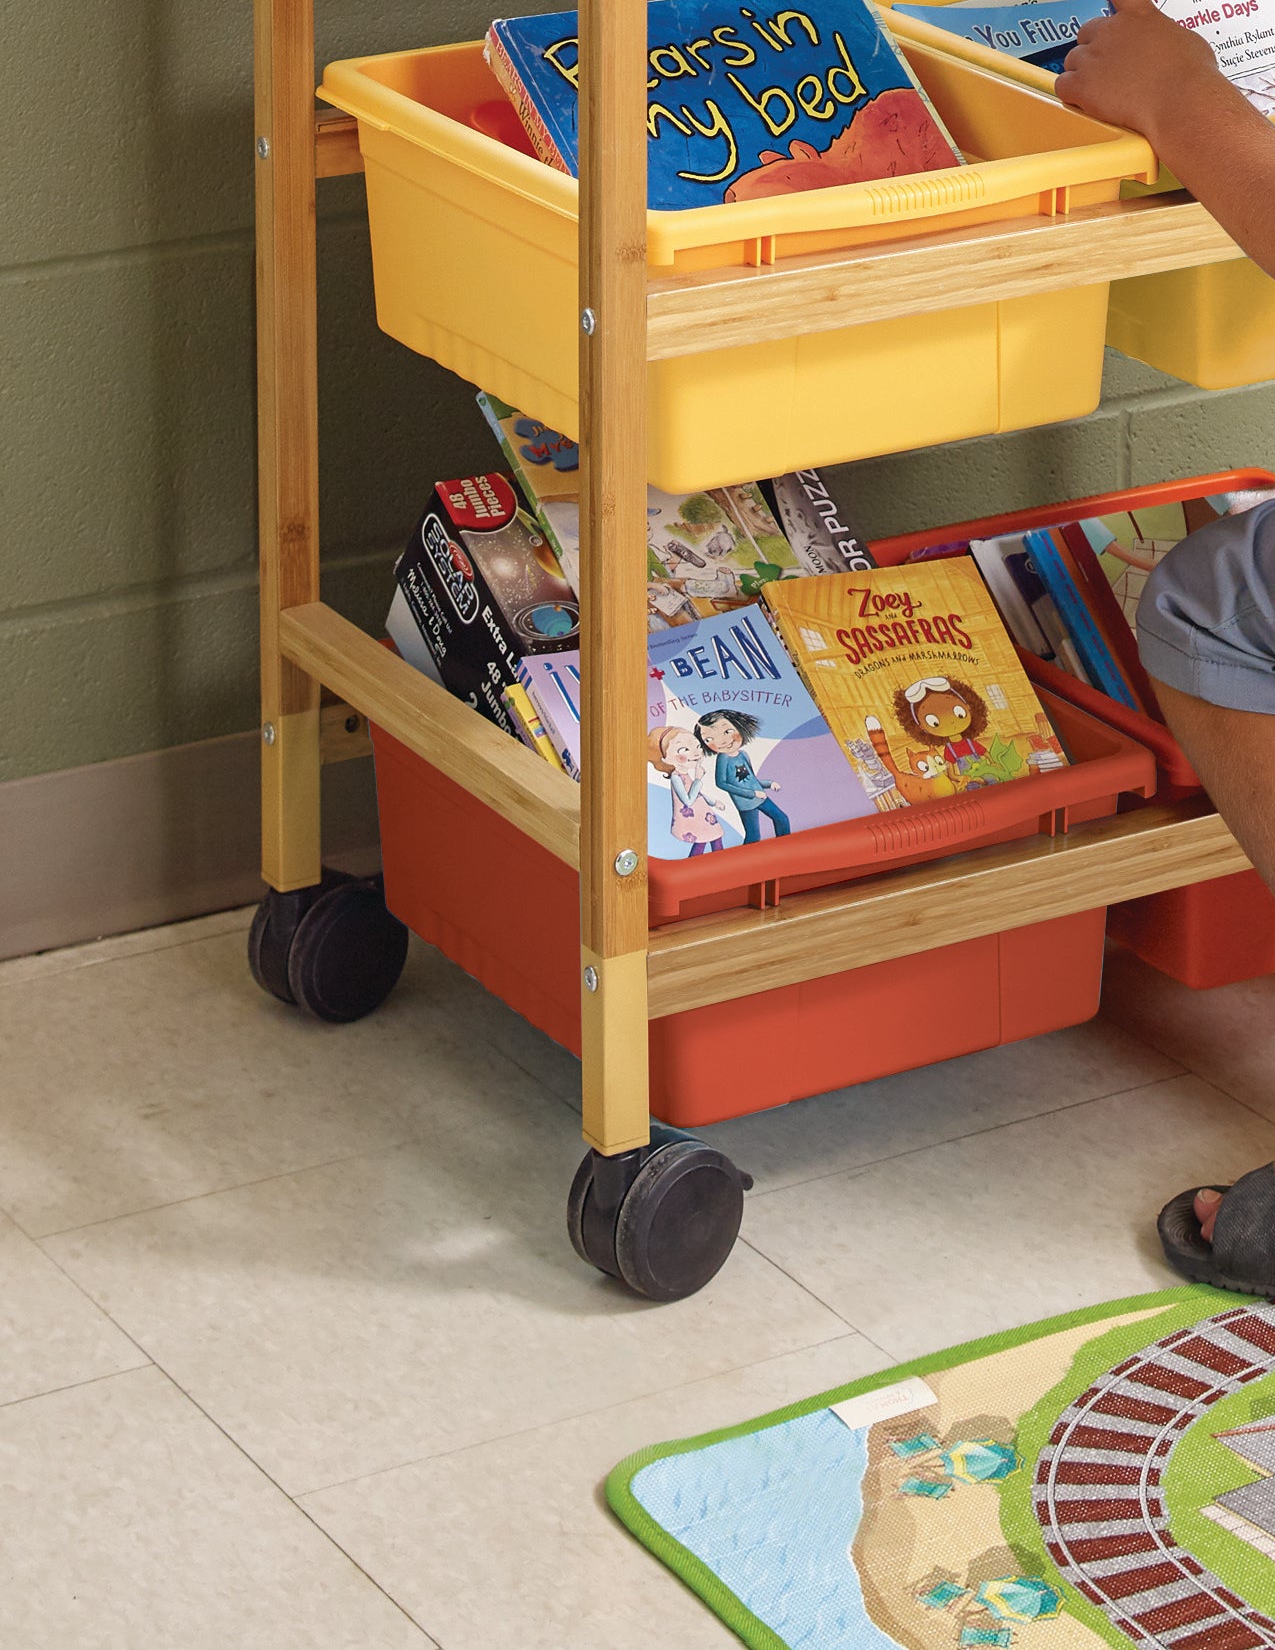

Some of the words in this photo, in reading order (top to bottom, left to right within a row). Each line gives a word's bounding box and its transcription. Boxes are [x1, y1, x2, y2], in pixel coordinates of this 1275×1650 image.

[543, 25, 757, 92] Bars
[740, 8, 821, 53] in
[973, 24, 1022, 50] You
[1018, 16, 1081, 44] Filled
[1209, 36, 1244, 53] Cynthia
[1244, 28, 1275, 43] Rylant
[726, 31, 869, 137] bed
[519, 101, 544, 154] Winnie
[449, 494, 460, 510] 48
[460, 479, 483, 518] Jumbo
[476, 476, 505, 517] Pieces
[796, 469, 849, 533] PUZZ
[426, 532, 468, 615] SYSTEM
[432, 522, 474, 605] SOLAR
[407, 568, 429, 616] Melissa
[432, 623, 447, 658] Doug
[847, 588, 922, 617] Zoey
[482, 605, 506, 655] Extra
[670, 616, 782, 681] BEAN
[836, 614, 972, 665] SASSAFRAS
[486, 662, 501, 685] 48
[855, 658, 890, 679] DRAGONS
[649, 703, 666, 718] OF
[669, 695, 701, 710] THE
[702, 691, 792, 708] BABYSITTER
